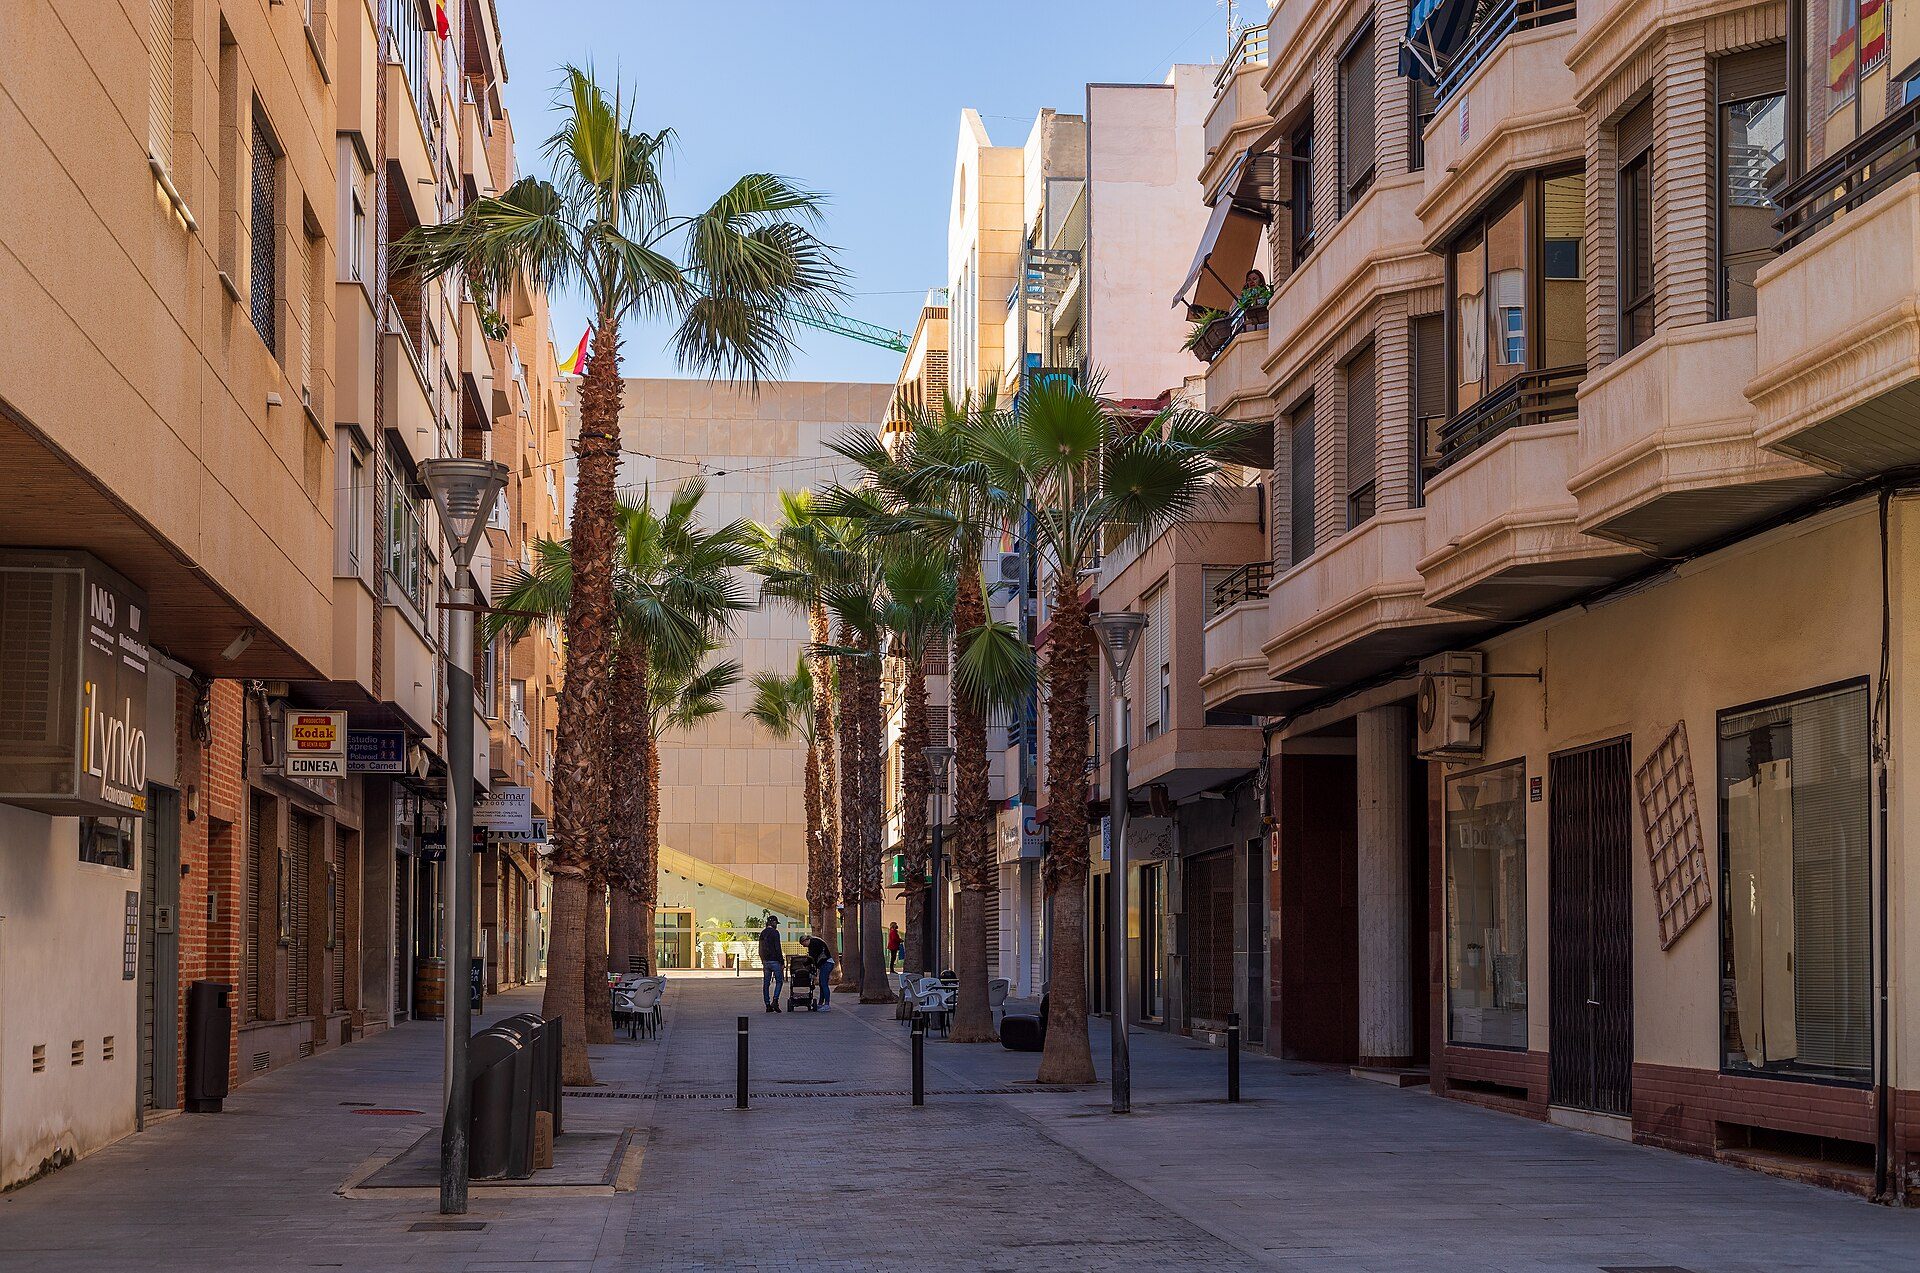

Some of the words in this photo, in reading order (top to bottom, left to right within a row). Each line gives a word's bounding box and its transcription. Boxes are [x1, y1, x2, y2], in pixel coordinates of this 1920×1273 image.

[295, 728, 333, 738] Kodak
[83, 680, 146, 799] iLynko
[293, 760, 338, 772] CONESA
[347, 762, 365, 770] otos
[369, 762, 397, 770] Carnet
